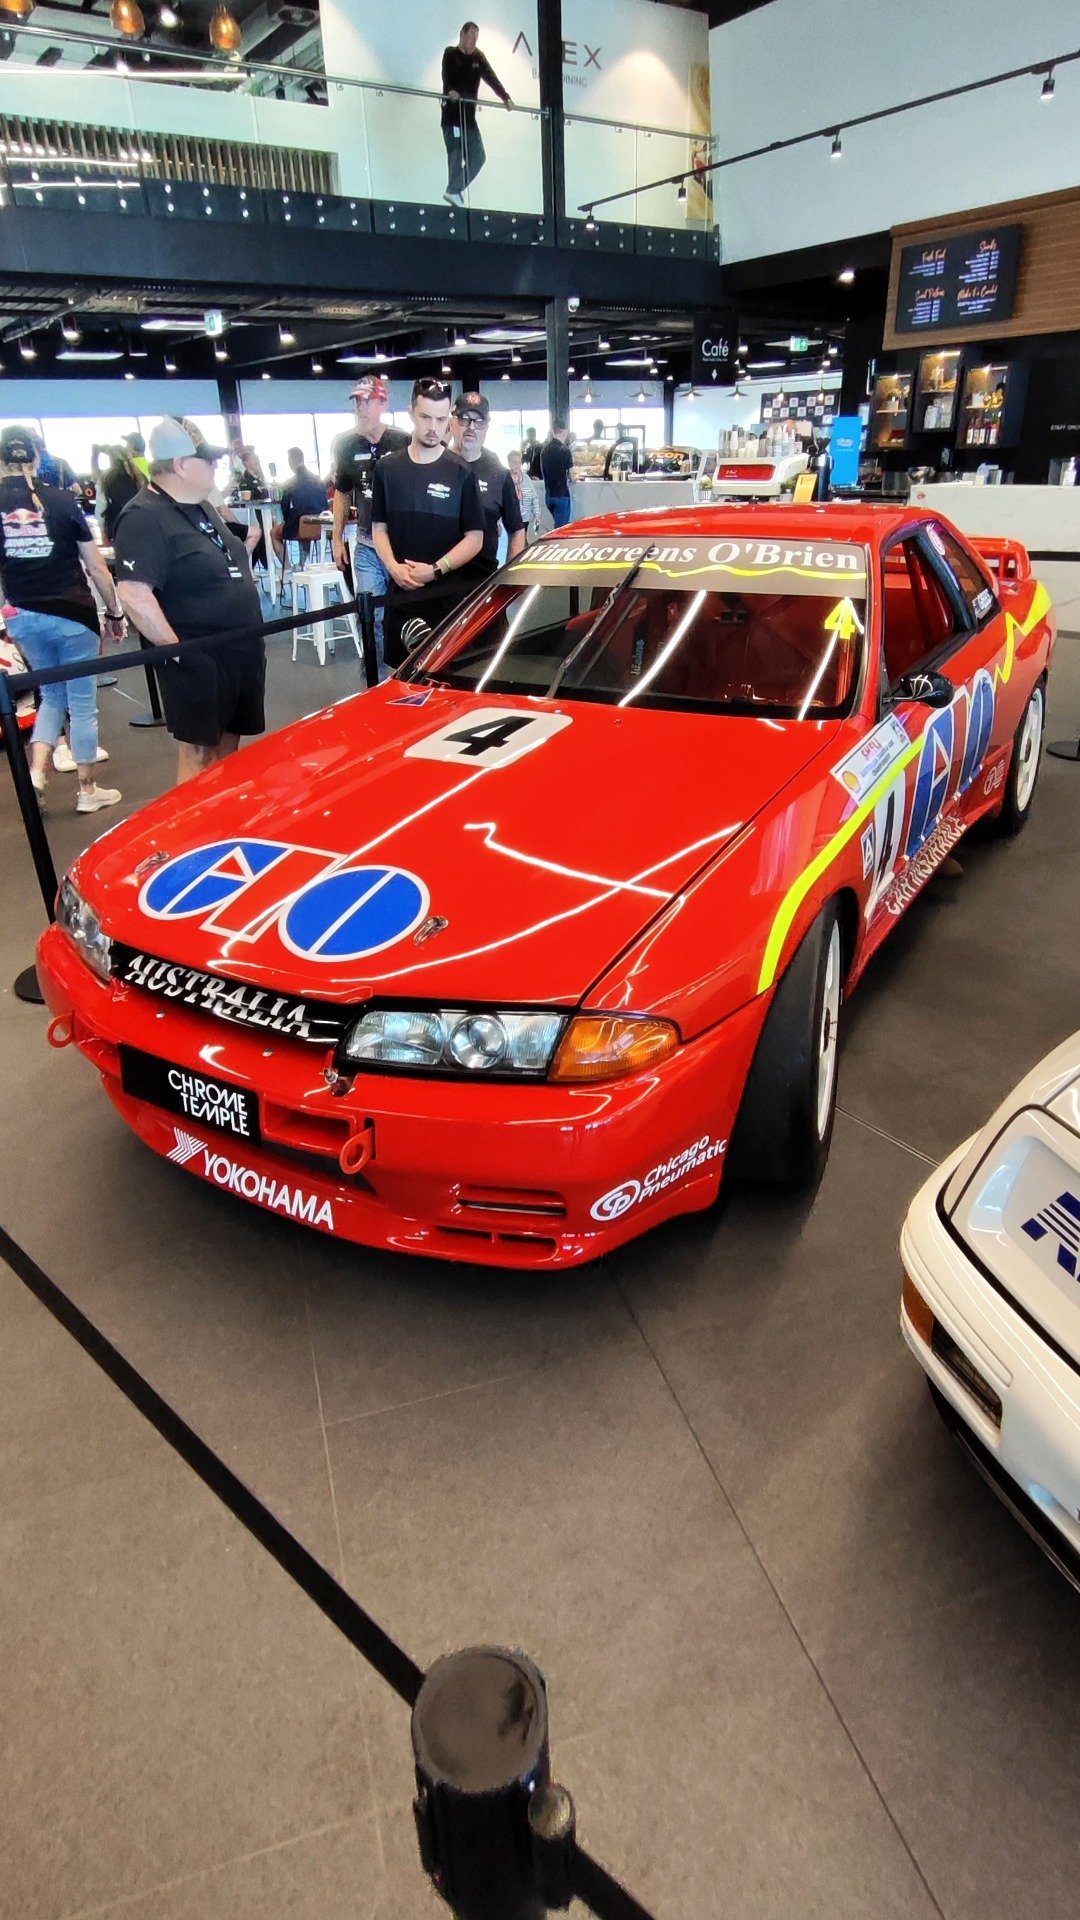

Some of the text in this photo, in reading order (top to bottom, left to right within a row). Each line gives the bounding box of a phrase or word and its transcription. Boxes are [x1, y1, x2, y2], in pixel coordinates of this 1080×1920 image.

[512, 31, 601, 70] AEX
[701, 337, 729, 357] Café
[519, 542, 858, 570] Windscreens O'Brien
[443, 715, 538, 757] 4
[124, 954, 310, 1038] AUSTRALIA
[168, 1069, 248, 1116] CHROME
[180, 1091, 250, 1137] TEMPLE
[638, 1139, 728, 1203] Pneumatic
[643, 1134, 710, 1187] Chicago
[203, 1149, 334, 1231] YOKOHAMA
